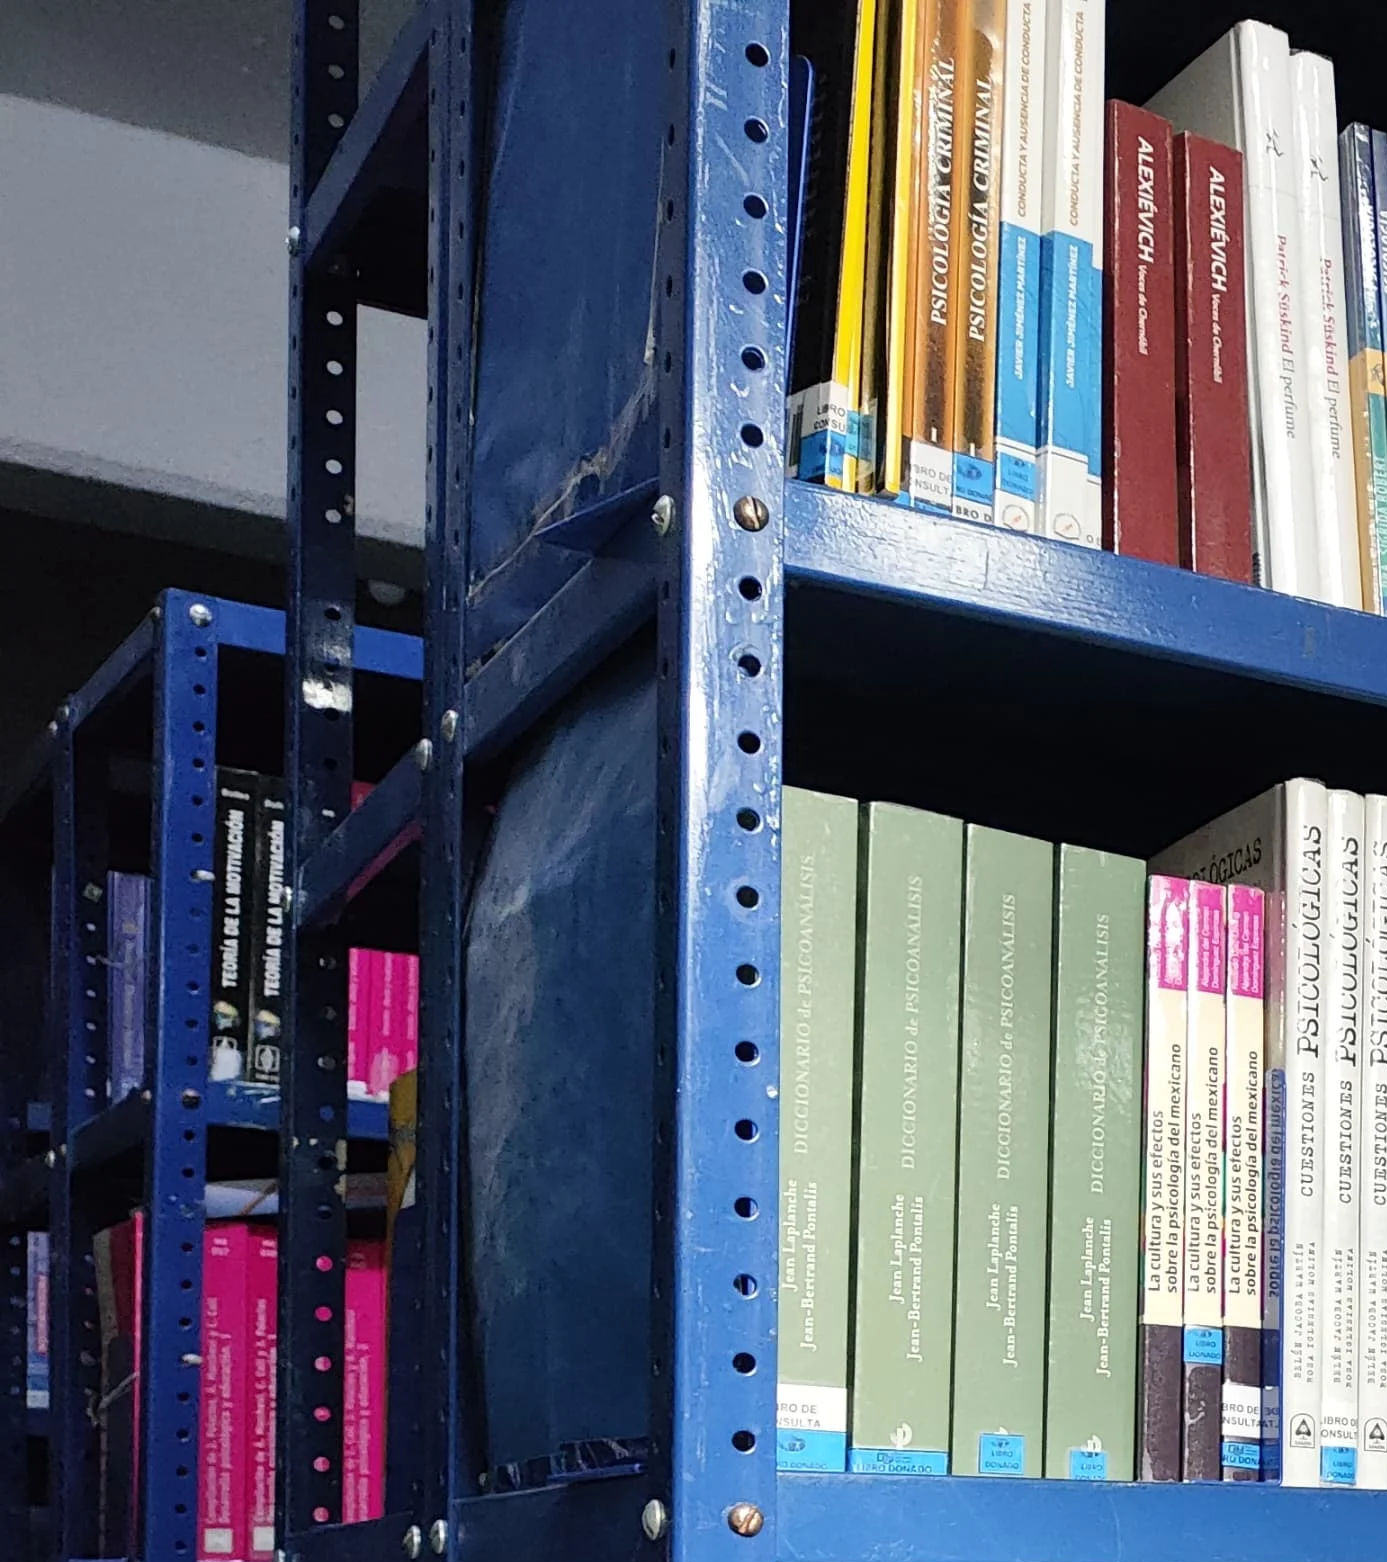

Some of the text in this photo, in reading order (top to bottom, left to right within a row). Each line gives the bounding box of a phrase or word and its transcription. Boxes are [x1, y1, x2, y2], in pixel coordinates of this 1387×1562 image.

[967, 77, 993, 342] PSICOLOGÍA CRIMINAL
[1137, 137, 1158, 262] ALEXIÉVICH
[1209, 166, 1230, 292] ALEXIÉVICH
[1276, 234, 1297, 440] Patrick Süskind El perfume
[219, 809, 244, 990] TEORÍA DE LA MOTIVACIÓN
[901, 876, 921, 1171] DICCIONARIO de PSICOANÁLISIS
[1291, 826, 1321, 1198] CUESTIONES PSICOLÓGICAS
[889, 1194, 907, 1304] Jean Laplanche
[1229, 1117, 1244, 1295] La cultura y sus efectos
[1245, 1051, 1261, 1296] sobre la psicología del mexicano
[905, 1195, 924, 1363] Jean-Bertrand Pontalis
